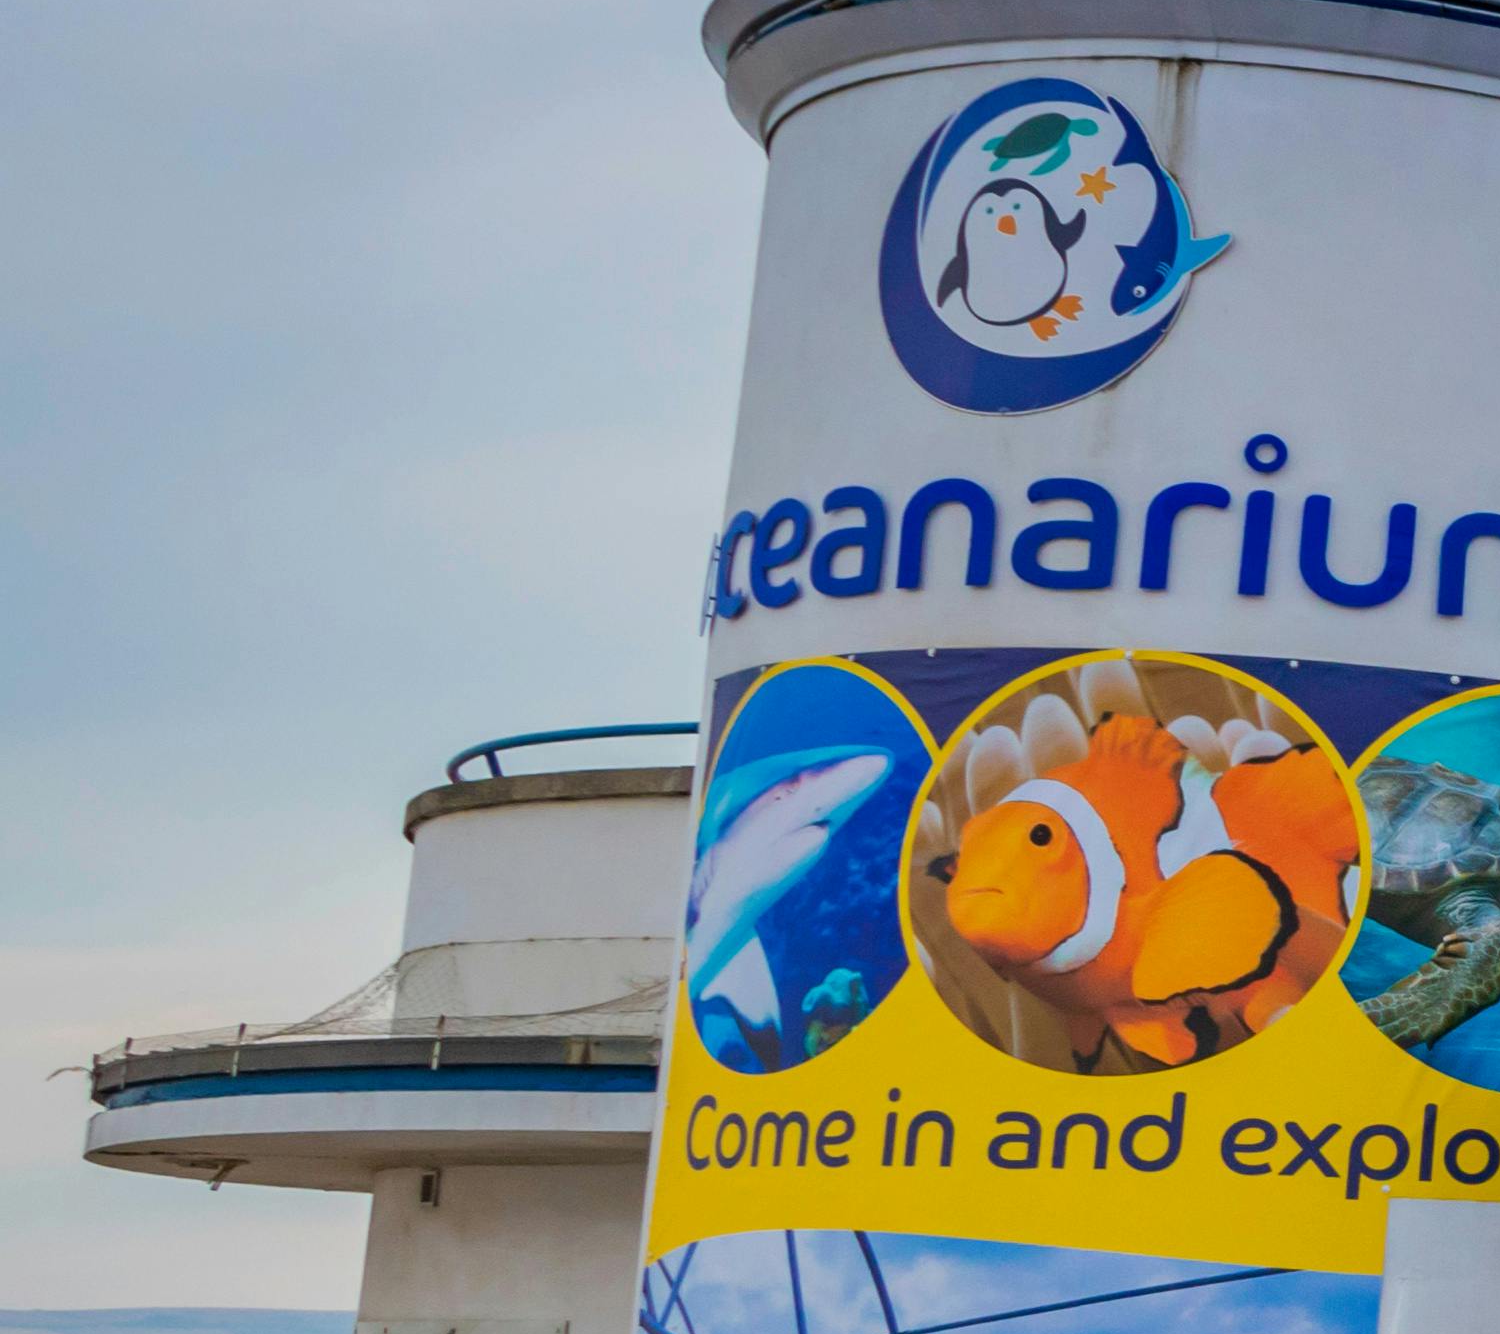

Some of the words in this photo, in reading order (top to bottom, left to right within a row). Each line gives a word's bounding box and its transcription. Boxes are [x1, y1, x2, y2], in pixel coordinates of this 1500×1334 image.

[686, 1094, 856, 1171] Come
[881, 1087, 955, 1169] in
[987, 1091, 1187, 1173] and
